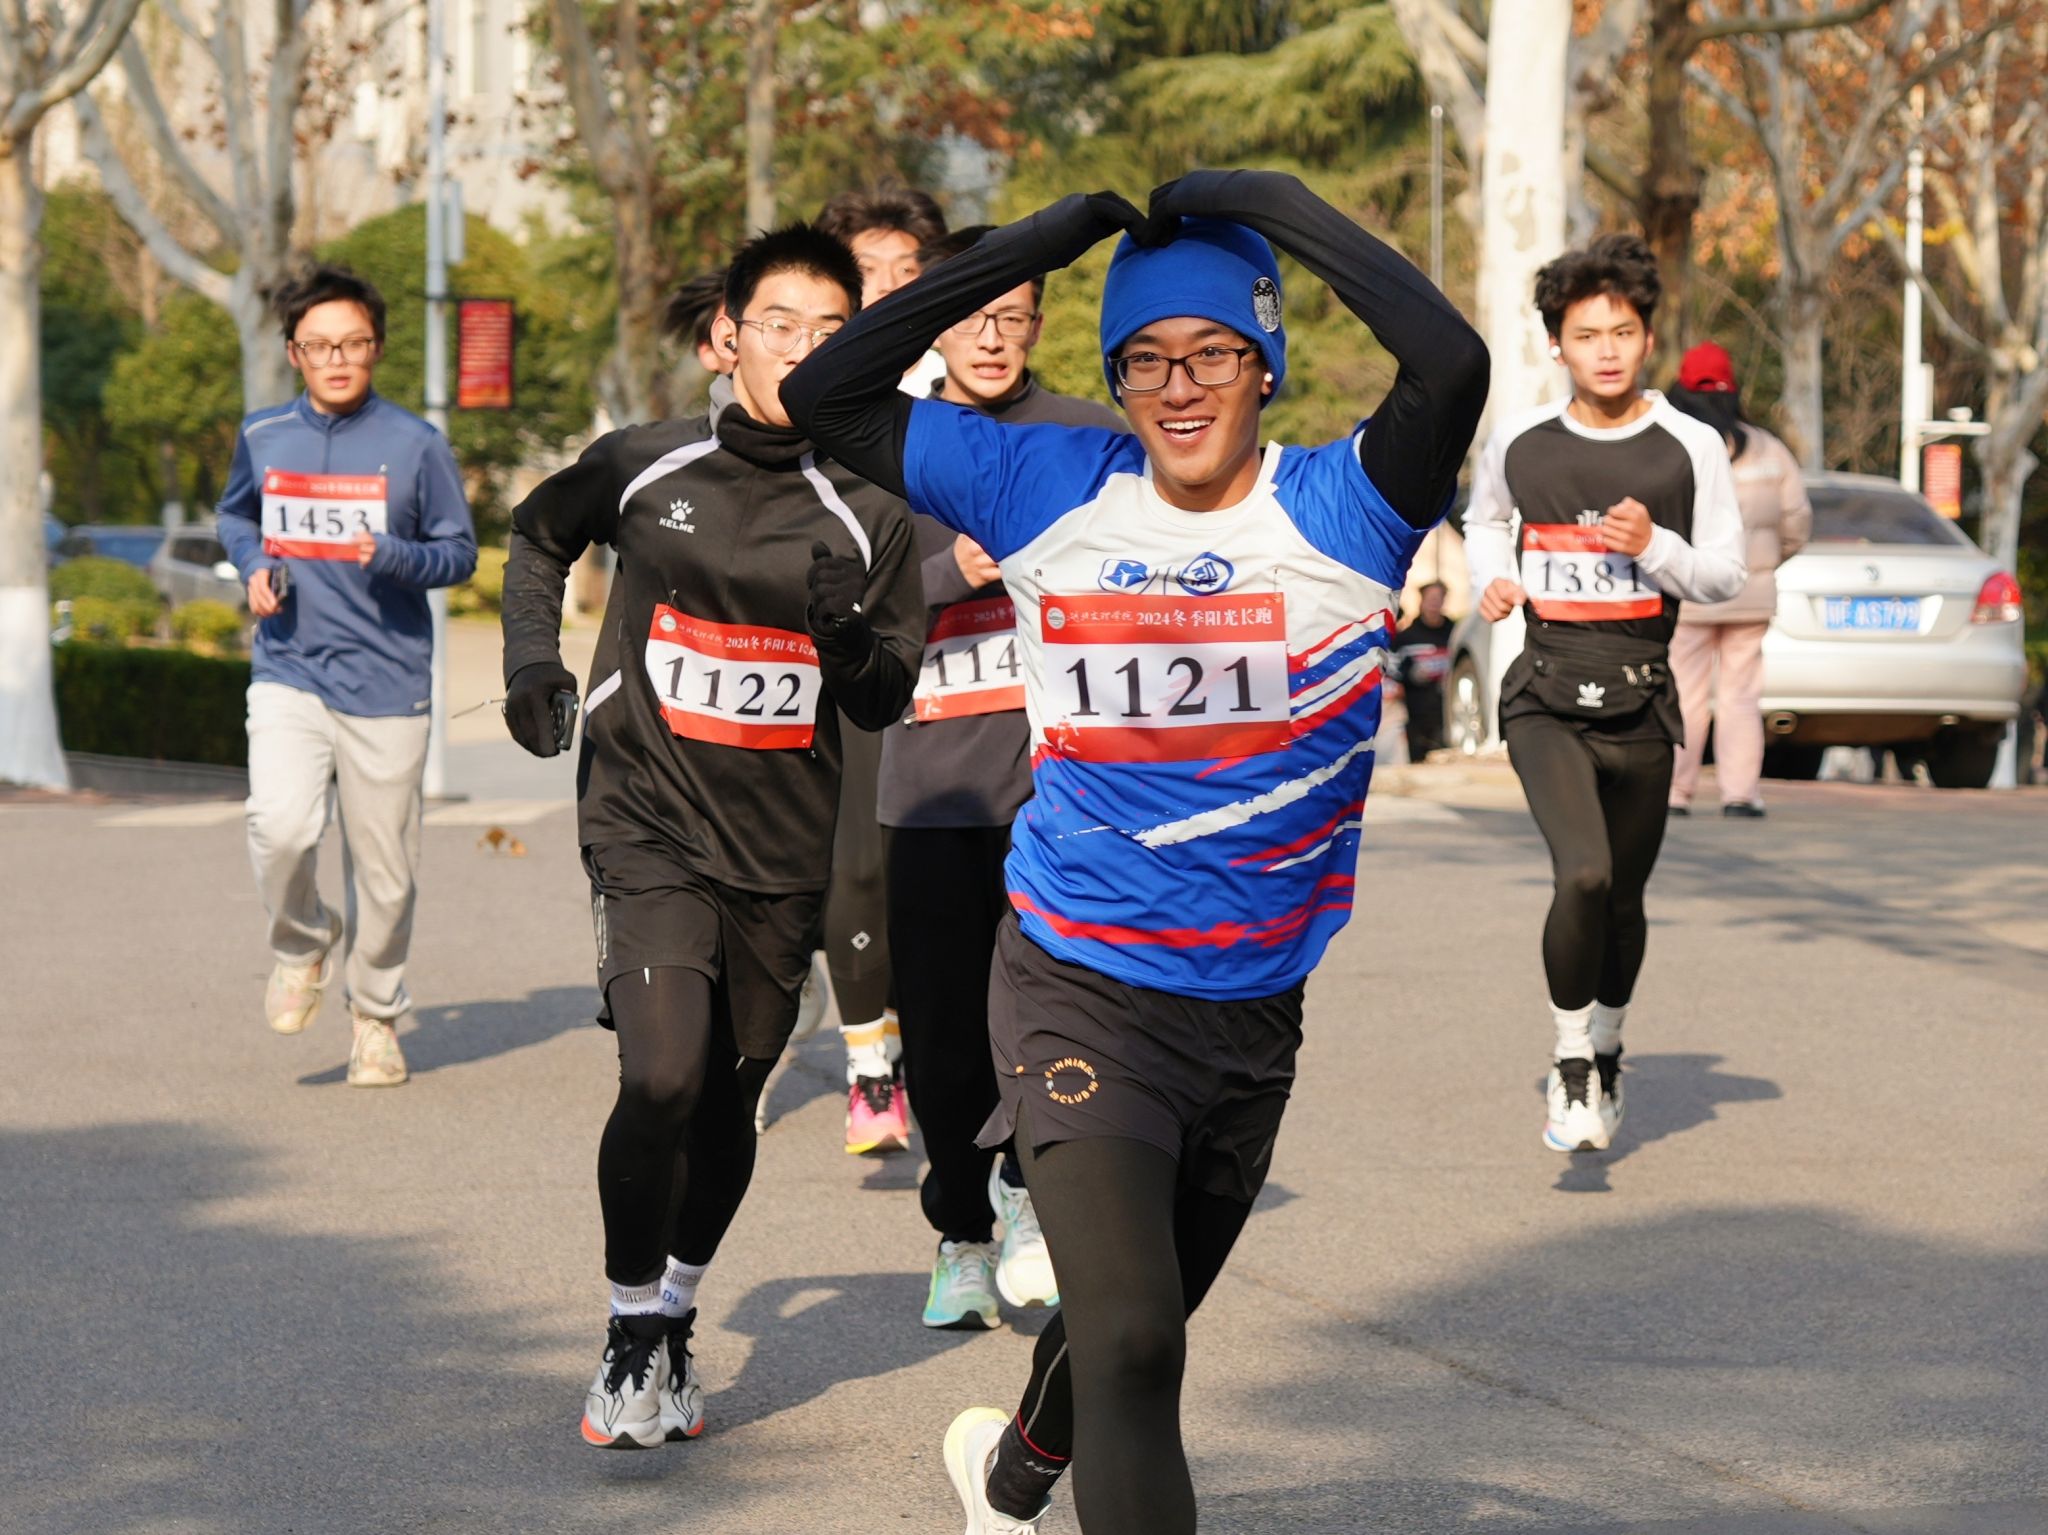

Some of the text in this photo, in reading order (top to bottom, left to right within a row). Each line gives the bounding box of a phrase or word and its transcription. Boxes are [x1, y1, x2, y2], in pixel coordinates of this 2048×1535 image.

[277, 504, 371, 536] 1453
[659, 517, 695, 534] KELME
[1542, 560, 1641, 594] 1381
[1136, 607, 1273, 627] 2024冬季阳光长跑
[665, 656, 801, 717] 1122
[1065, 656, 1261, 717] 1121
